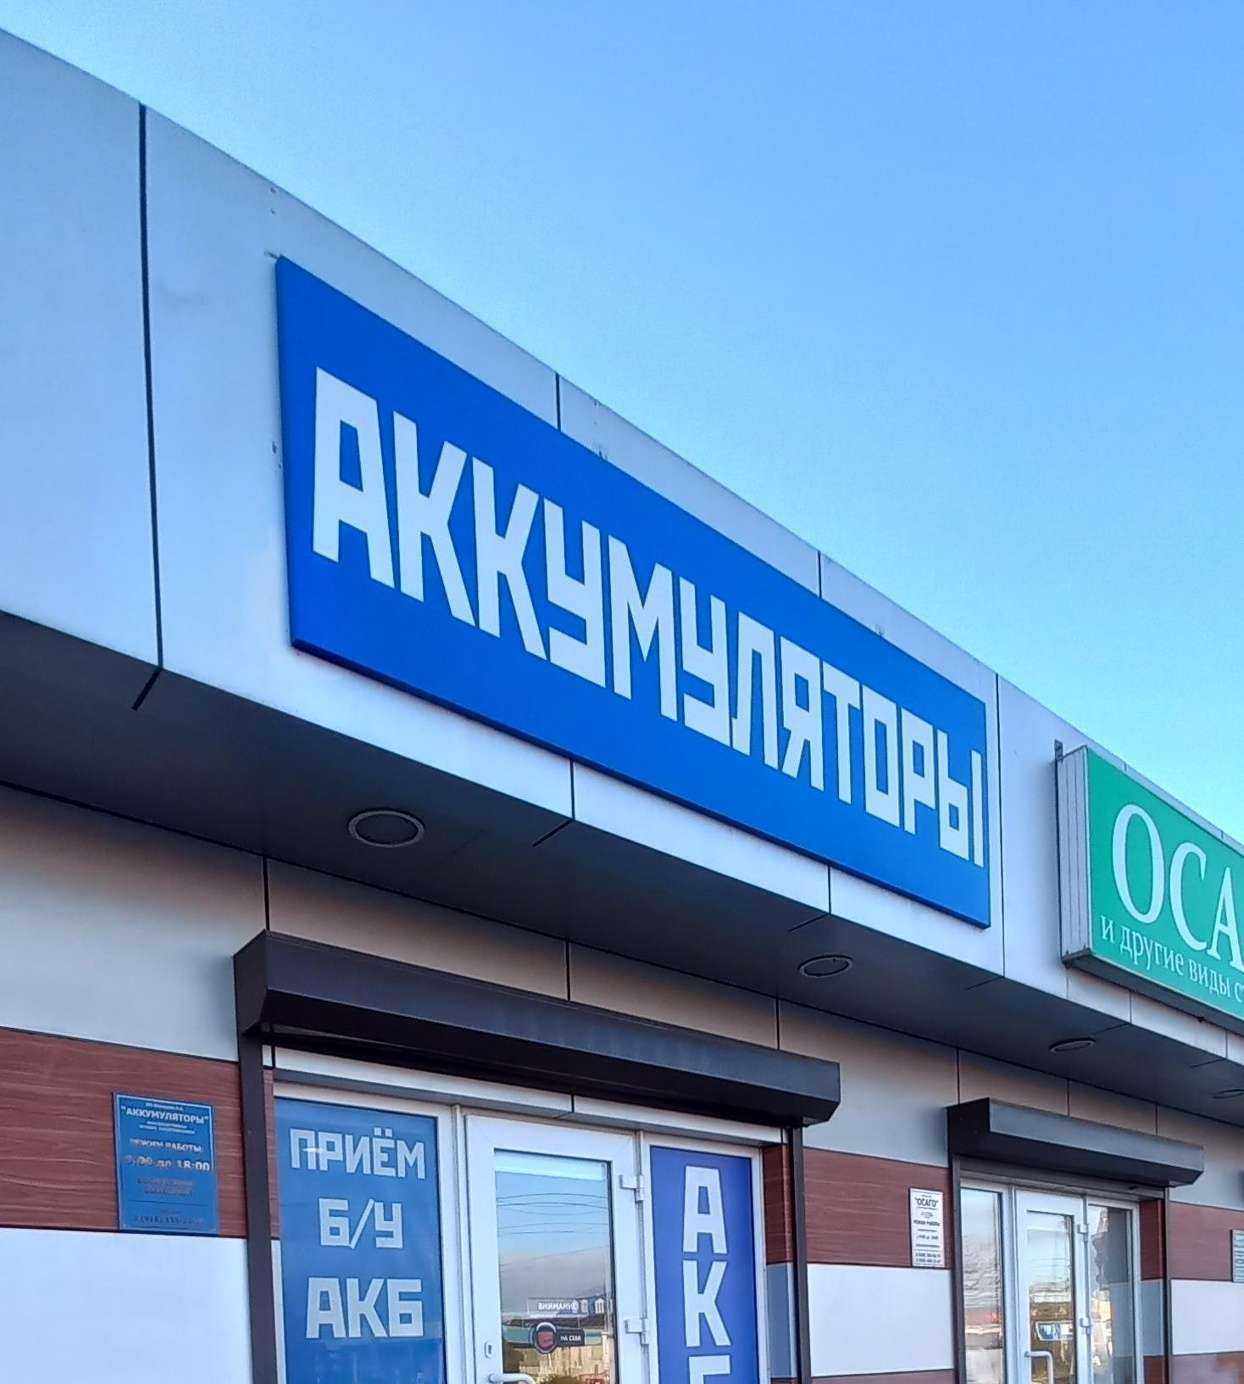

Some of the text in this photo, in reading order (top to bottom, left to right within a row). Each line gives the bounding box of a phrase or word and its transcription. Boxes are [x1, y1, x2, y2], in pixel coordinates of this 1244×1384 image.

[312, 366, 984, 868] АККУМУЛЯТОРЫ
[1101, 915, 1114, 943] и
[1120, 925, 1184, 976] другие
[1188, 960, 1231, 997] виды
[289, 1127, 425, 1179] ПРИЁМ
[318, 1198, 403, 1249] Б/У
[306, 1277, 424, 1339] АКБ
